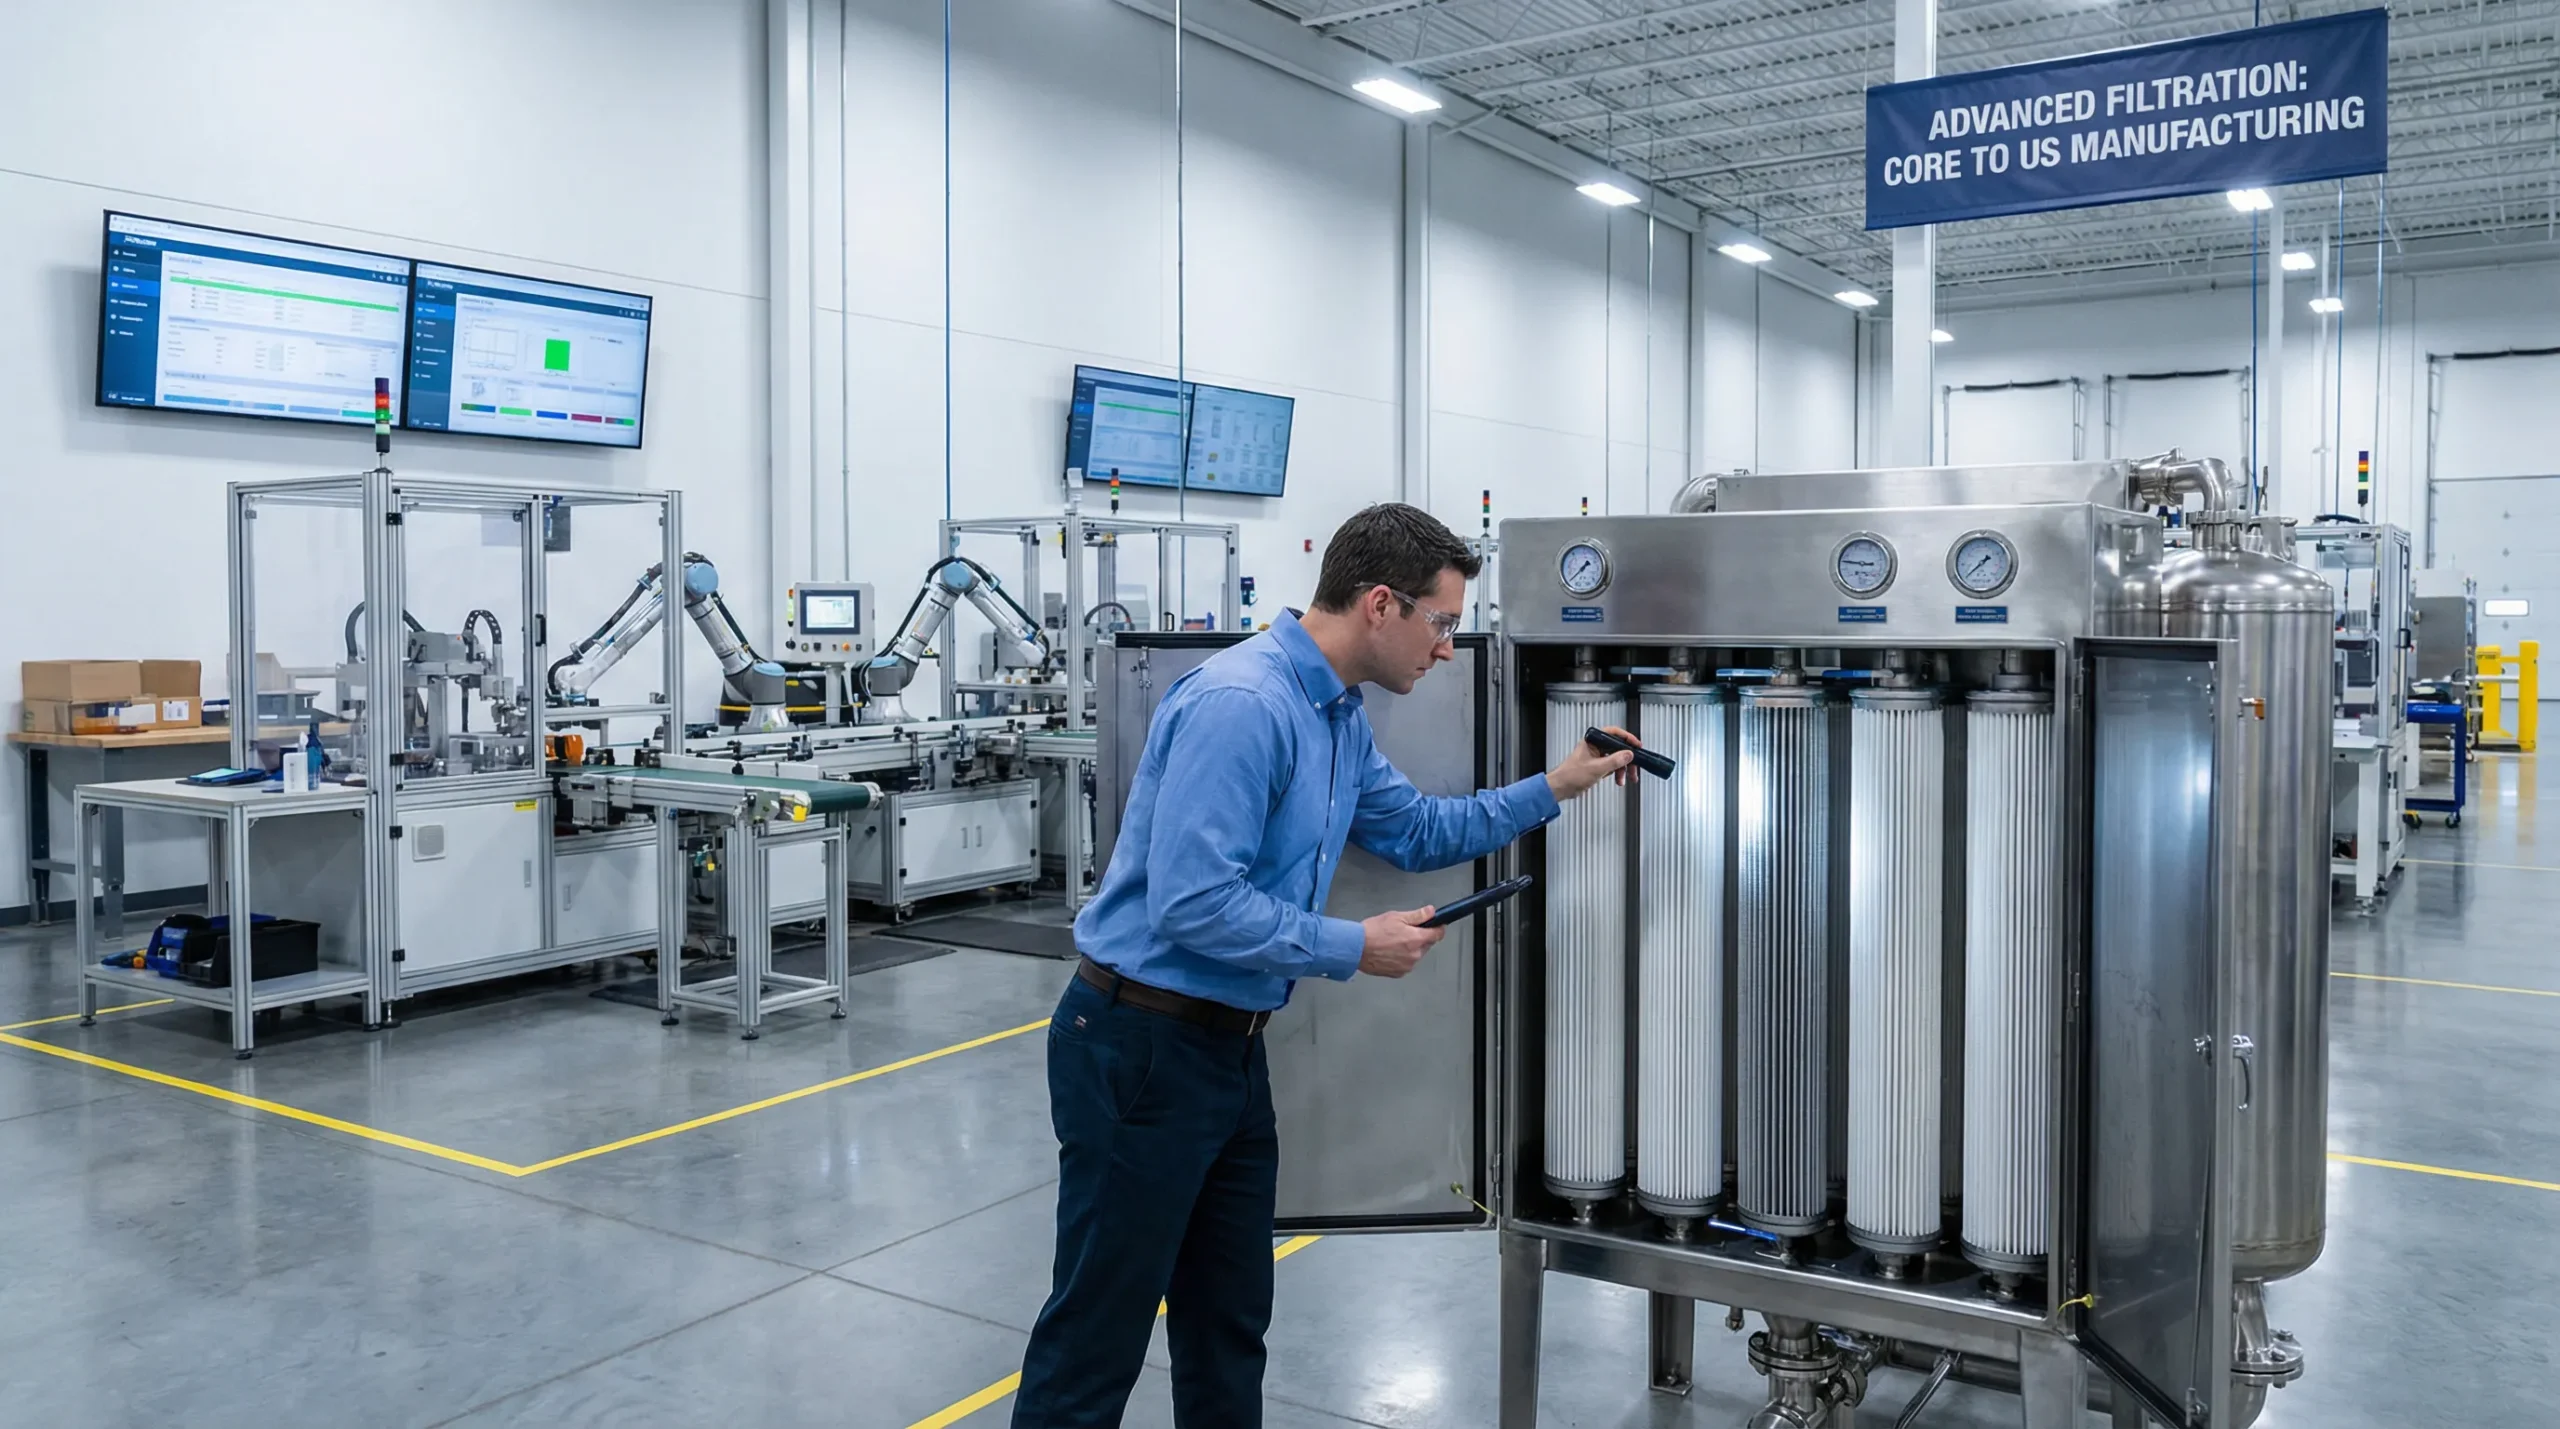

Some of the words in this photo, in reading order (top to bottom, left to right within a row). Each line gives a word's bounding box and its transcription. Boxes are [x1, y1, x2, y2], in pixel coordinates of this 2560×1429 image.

[1884, 149, 1962, 187] CORE
[1970, 143, 2010, 176] TO
[2019, 136, 2061, 170] US
[2070, 95, 2365, 164] MANUFACTURING
[1928, 89, 2096, 141] ADVANCED
[2106, 60, 2308, 117] FILTRATION:
